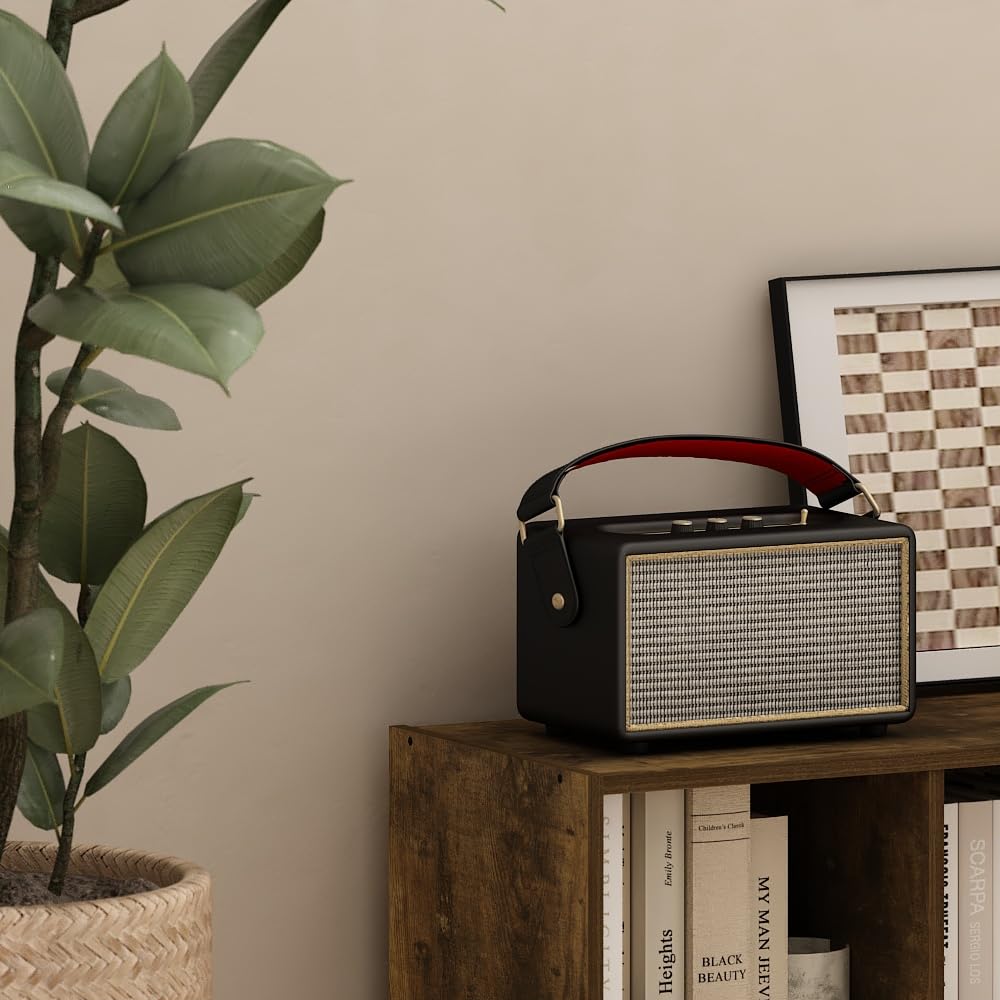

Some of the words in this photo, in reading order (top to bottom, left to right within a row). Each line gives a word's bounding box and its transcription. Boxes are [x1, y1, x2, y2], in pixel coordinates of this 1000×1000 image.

[664, 830, 673, 859] Bronte
[664, 861, 674, 887] Emily
[969, 839, 986, 916] SCARPA
[758, 876, 770, 904] MY
[758, 909, 770, 950] MAN
[969, 921, 982, 961] SERGIO
[657, 928, 676, 996] Heights
[702, 954, 743, 967] BLACK
[698, 969, 747, 983] BEAUTY
